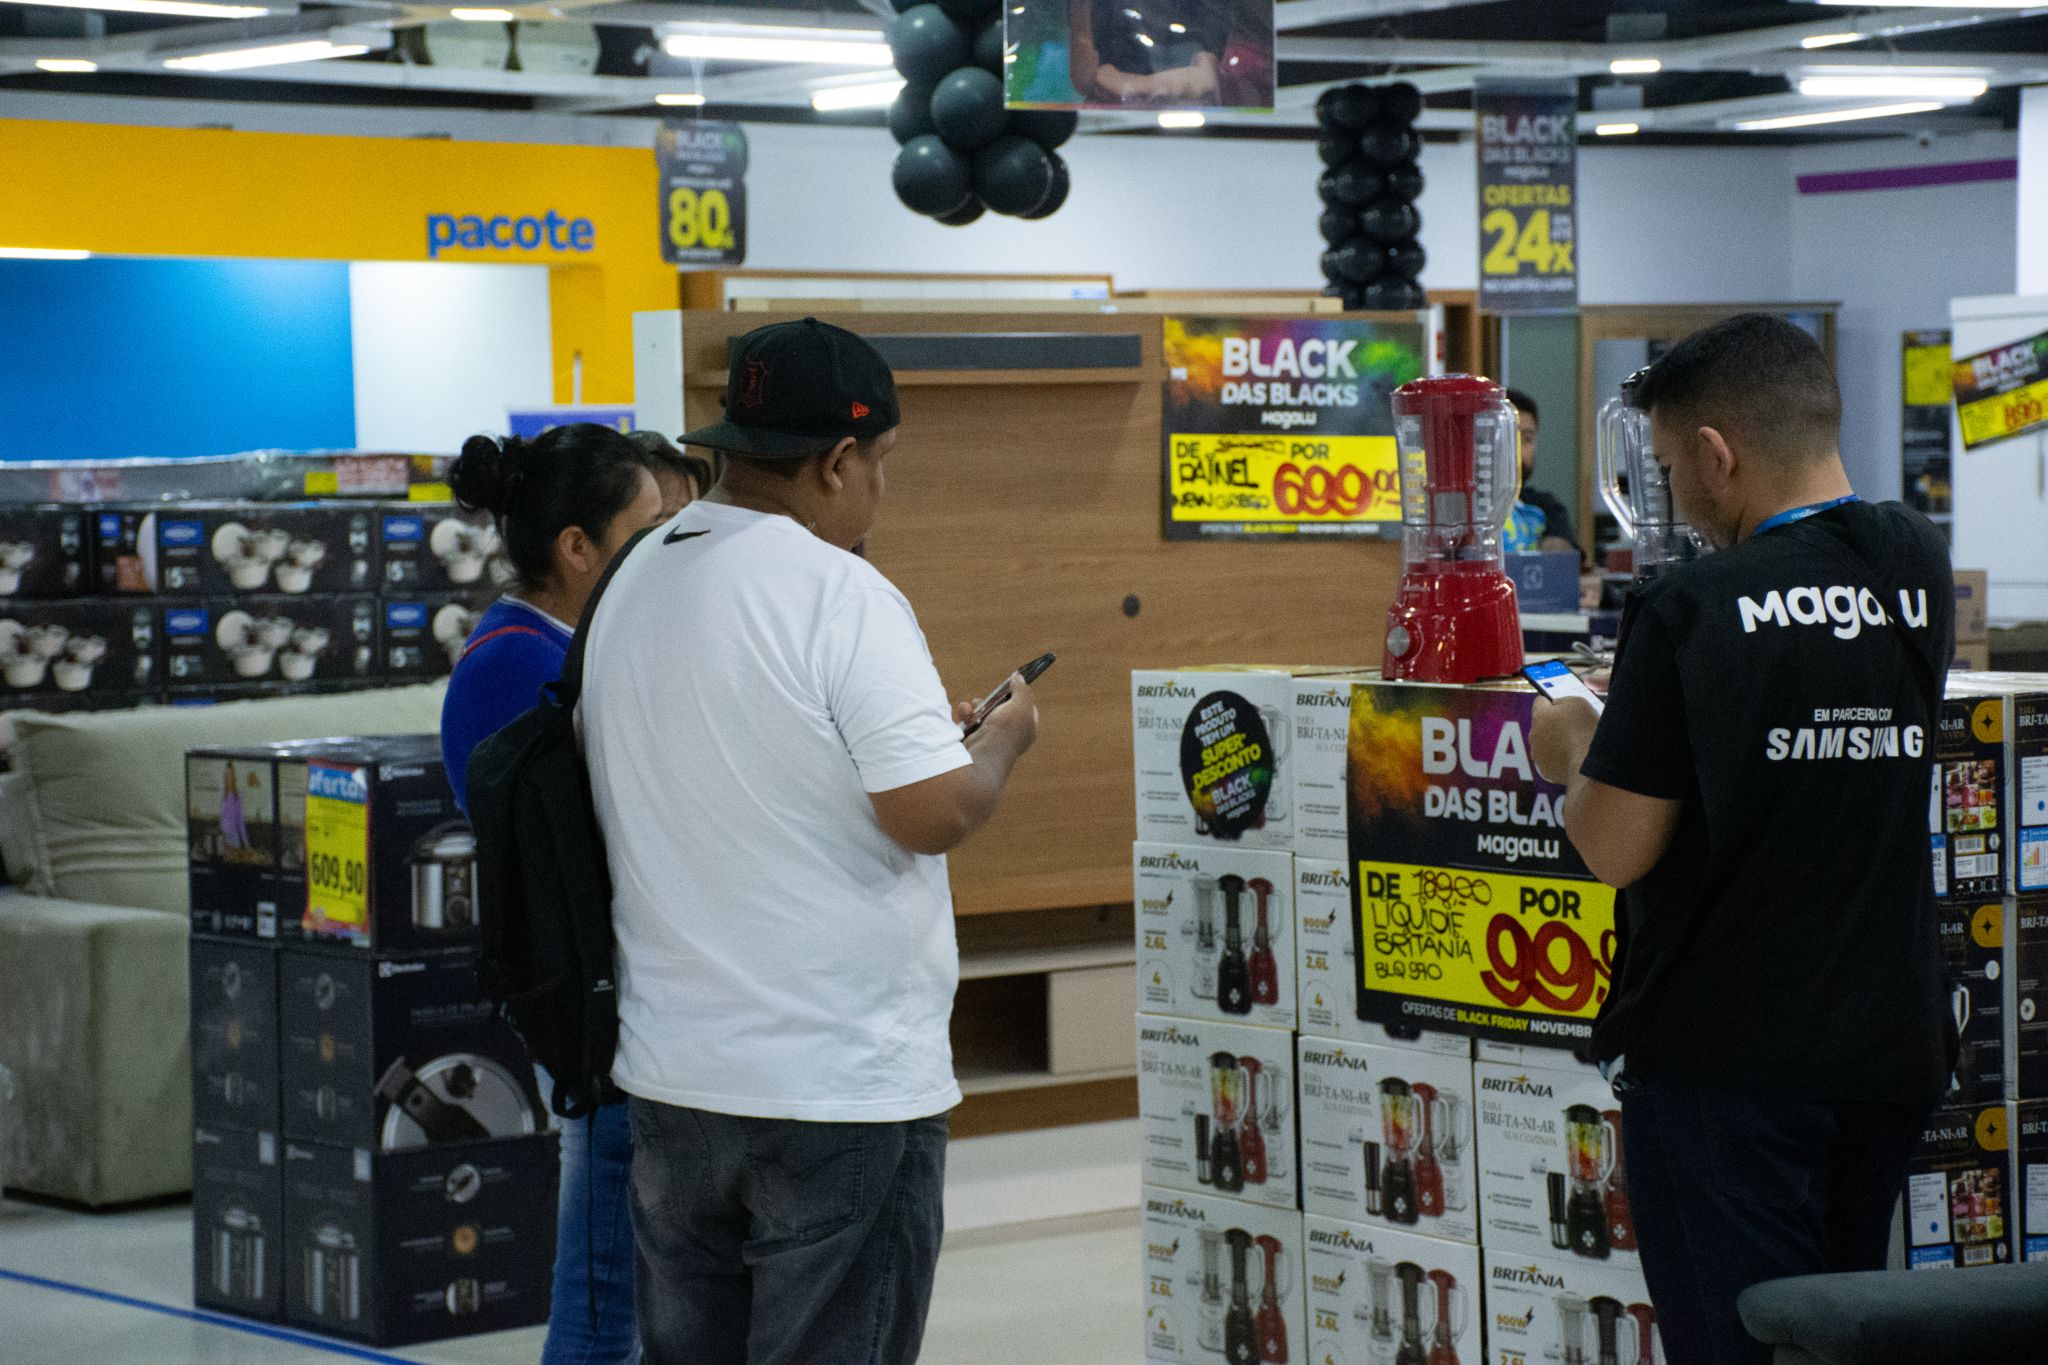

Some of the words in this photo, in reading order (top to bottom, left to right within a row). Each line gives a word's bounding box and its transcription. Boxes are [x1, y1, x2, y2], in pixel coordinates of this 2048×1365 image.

[1483, 115, 1568, 143] BLACK
[426, 208, 595, 258] pacote
[1222, 337, 1358, 378] BLACK
[1221, 382, 1266, 405] DAS
[1270, 383, 1359, 407] BLACKS
[1176, 442, 1200, 459] DE
[1291, 443, 1329, 460] POR
[1738, 586, 1927, 639] Magau
[1297, 693, 1350, 708] BRITANI
[1814, 709, 1829, 721] EM
[1192, 743, 1261, 789] DESCONTO
[1421, 716, 1535, 782] BLA
[1424, 785, 1482, 821] DAS
[312, 852, 362, 896] 609,90
[1301, 872, 1350, 888] BRITAN
[1367, 871, 1401, 899] DE
[1519, 886, 1581, 920] POR
[1402, 1001, 1442, 1018] OFERTAS
[1443, 1008, 1456, 1021] DE
[1457, 1010, 1489, 1026] BLACK
[1491, 1016, 1529, 1031] FRIDAY
[1530, 1020, 1593, 1038] NOVEMBR
[1482, 1078, 1553, 1098] BRITANIA
[1493, 1266, 1564, 1289] BRITANIA
